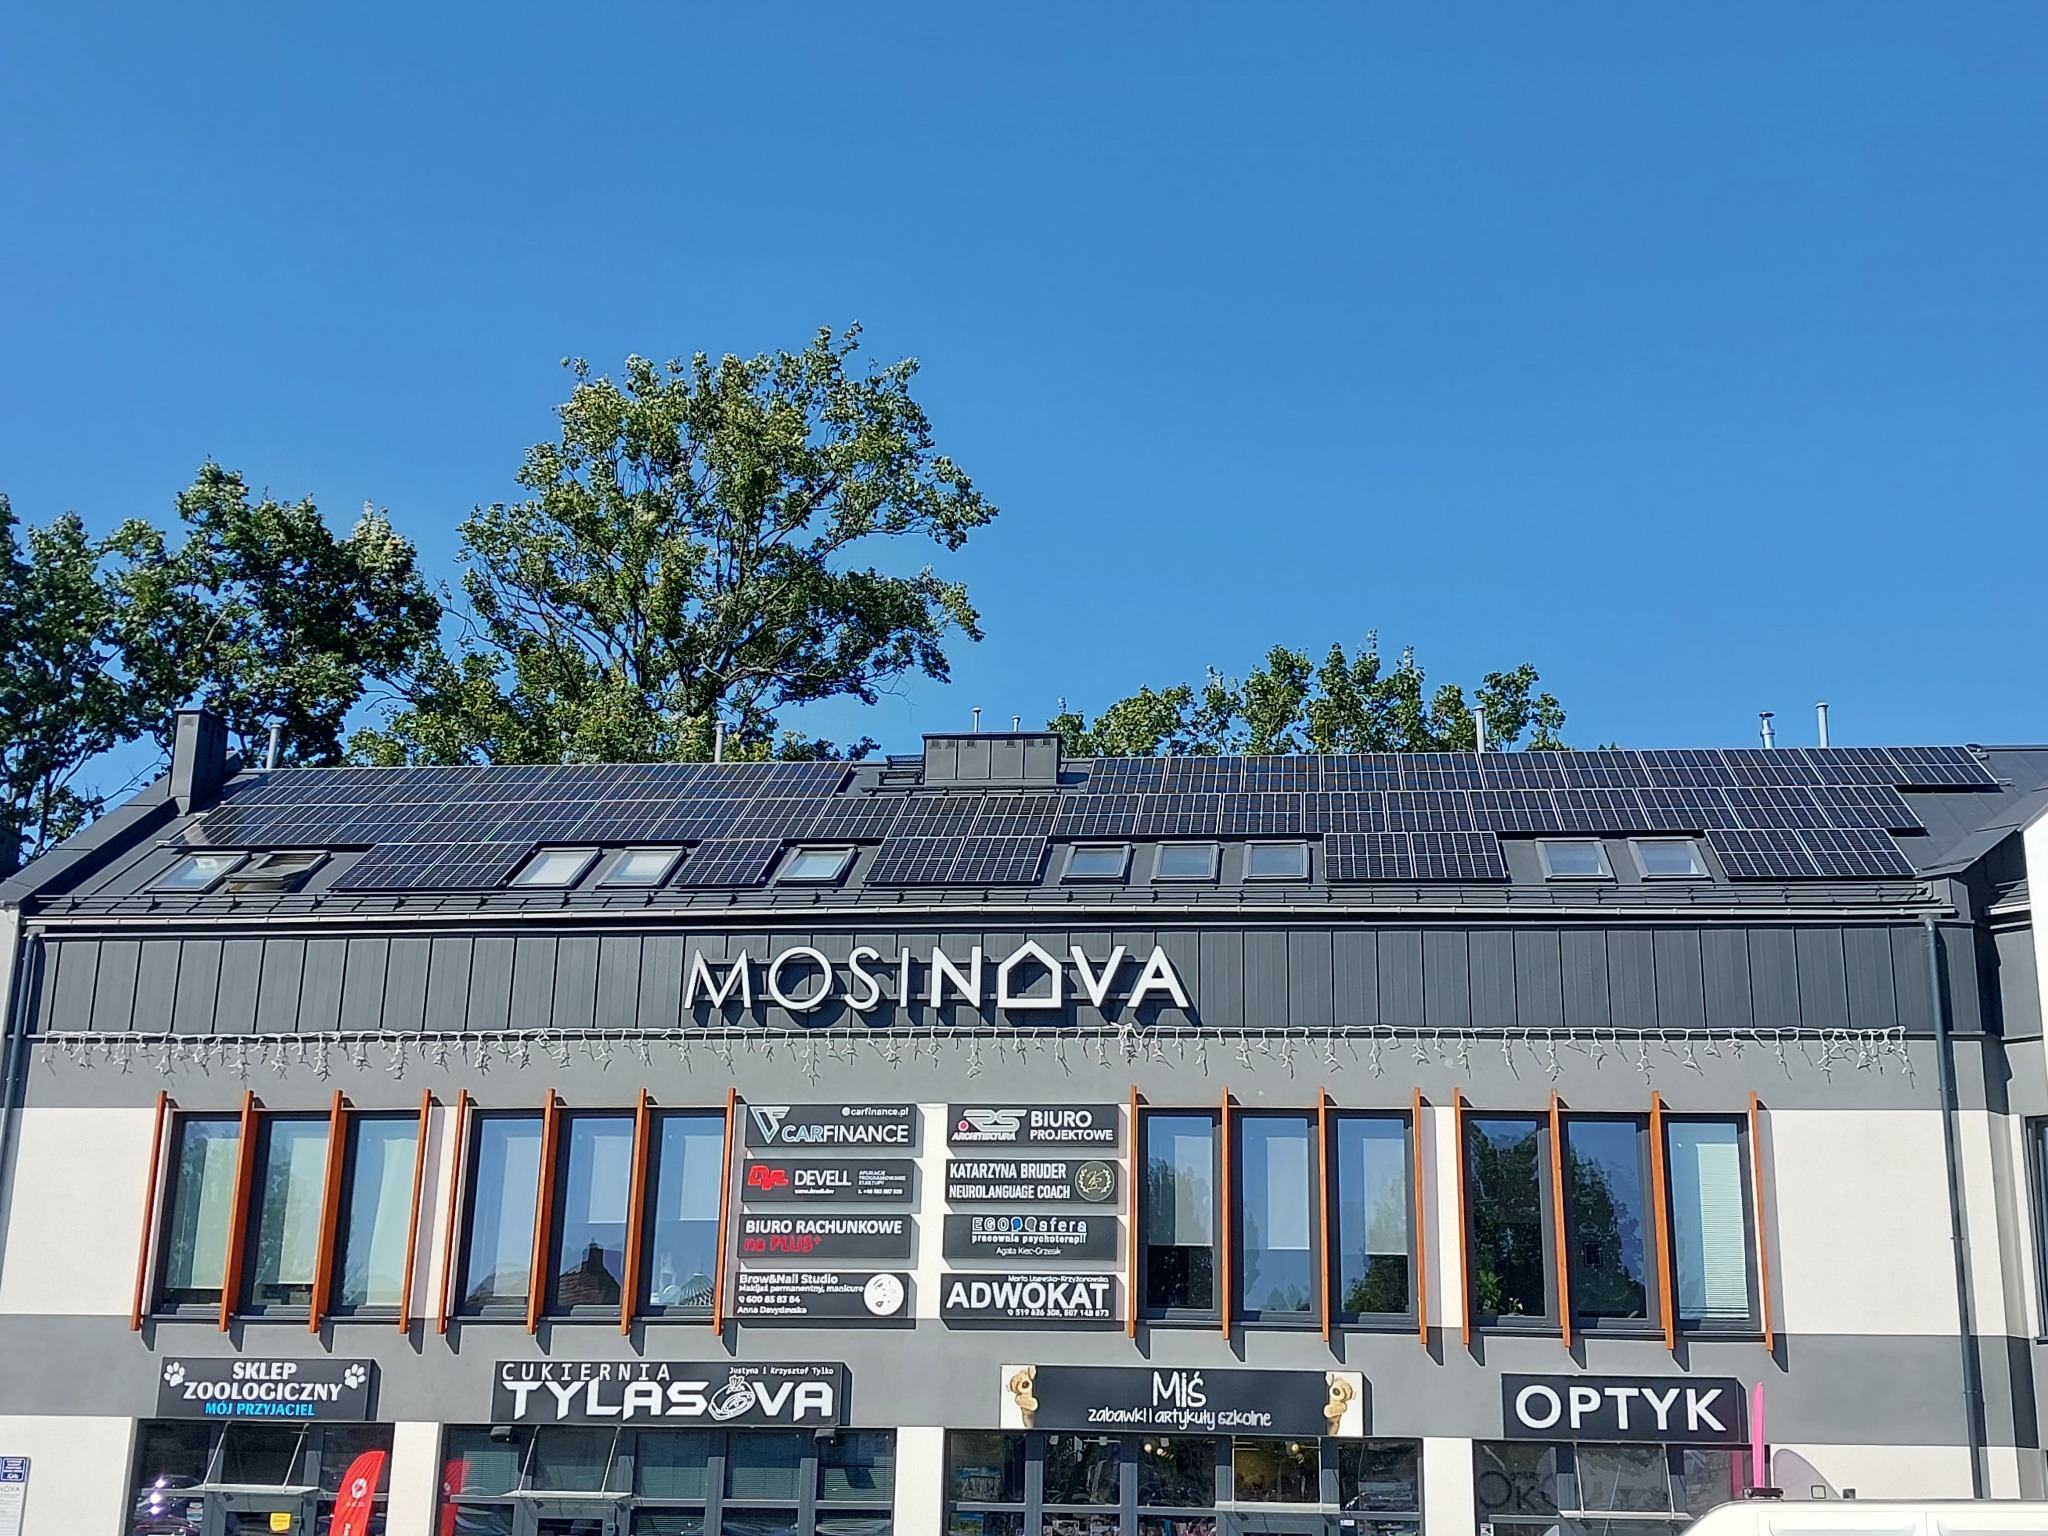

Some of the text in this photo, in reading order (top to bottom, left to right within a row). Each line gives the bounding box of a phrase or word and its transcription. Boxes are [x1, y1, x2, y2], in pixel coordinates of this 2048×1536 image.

[851, 1106, 909, 1117] carfinance.pl
[1030, 1110, 1093, 1128] BIURO
[782, 1125, 909, 1143] CARFINANCE
[1029, 1129, 1114, 1141] PROJEKTOWE
[794, 1170, 852, 1186] DEVELL
[949, 1163, 1067, 1179] KATARZYNA BRUDER
[948, 1184, 1071, 1199] NEUROLANGUAGE COACH
[745, 1219, 903, 1234] BIURO RACHUNKOWE
[743, 1237, 766, 1251] na
[971, 1234, 1087, 1245] pracownia psychoterapii
[996, 1246, 1017, 1257] Agata
[739, 1274, 838, 1284] Brow&Nail Studio
[826, 1285, 864, 1293] manicure
[945, 1281, 1110, 1309] ADWOKAT
[737, 1306, 758, 1314] Anna
[232, 1361, 297, 1380] SKLEP
[502, 1363, 671, 1381] CUKIERNIA
[729, 1366, 759, 1376] Justyna
[770, 1366, 809, 1377] Krzysztof
[811, 1366, 834, 1377] Tylko
[183, 1381, 343, 1401] ZOOLOGICZNY
[1152, 1370, 1207, 1408] Miś
[205, 1401, 316, 1416] MÓJ PRZYJACIEL
[1515, 1384, 1727, 1432] OPTYK
[1087, 1407, 1147, 1423] zabawki
[1155, 1407, 1216, 1431] artykuły
[1217, 1409, 1273, 1427] szkolne
